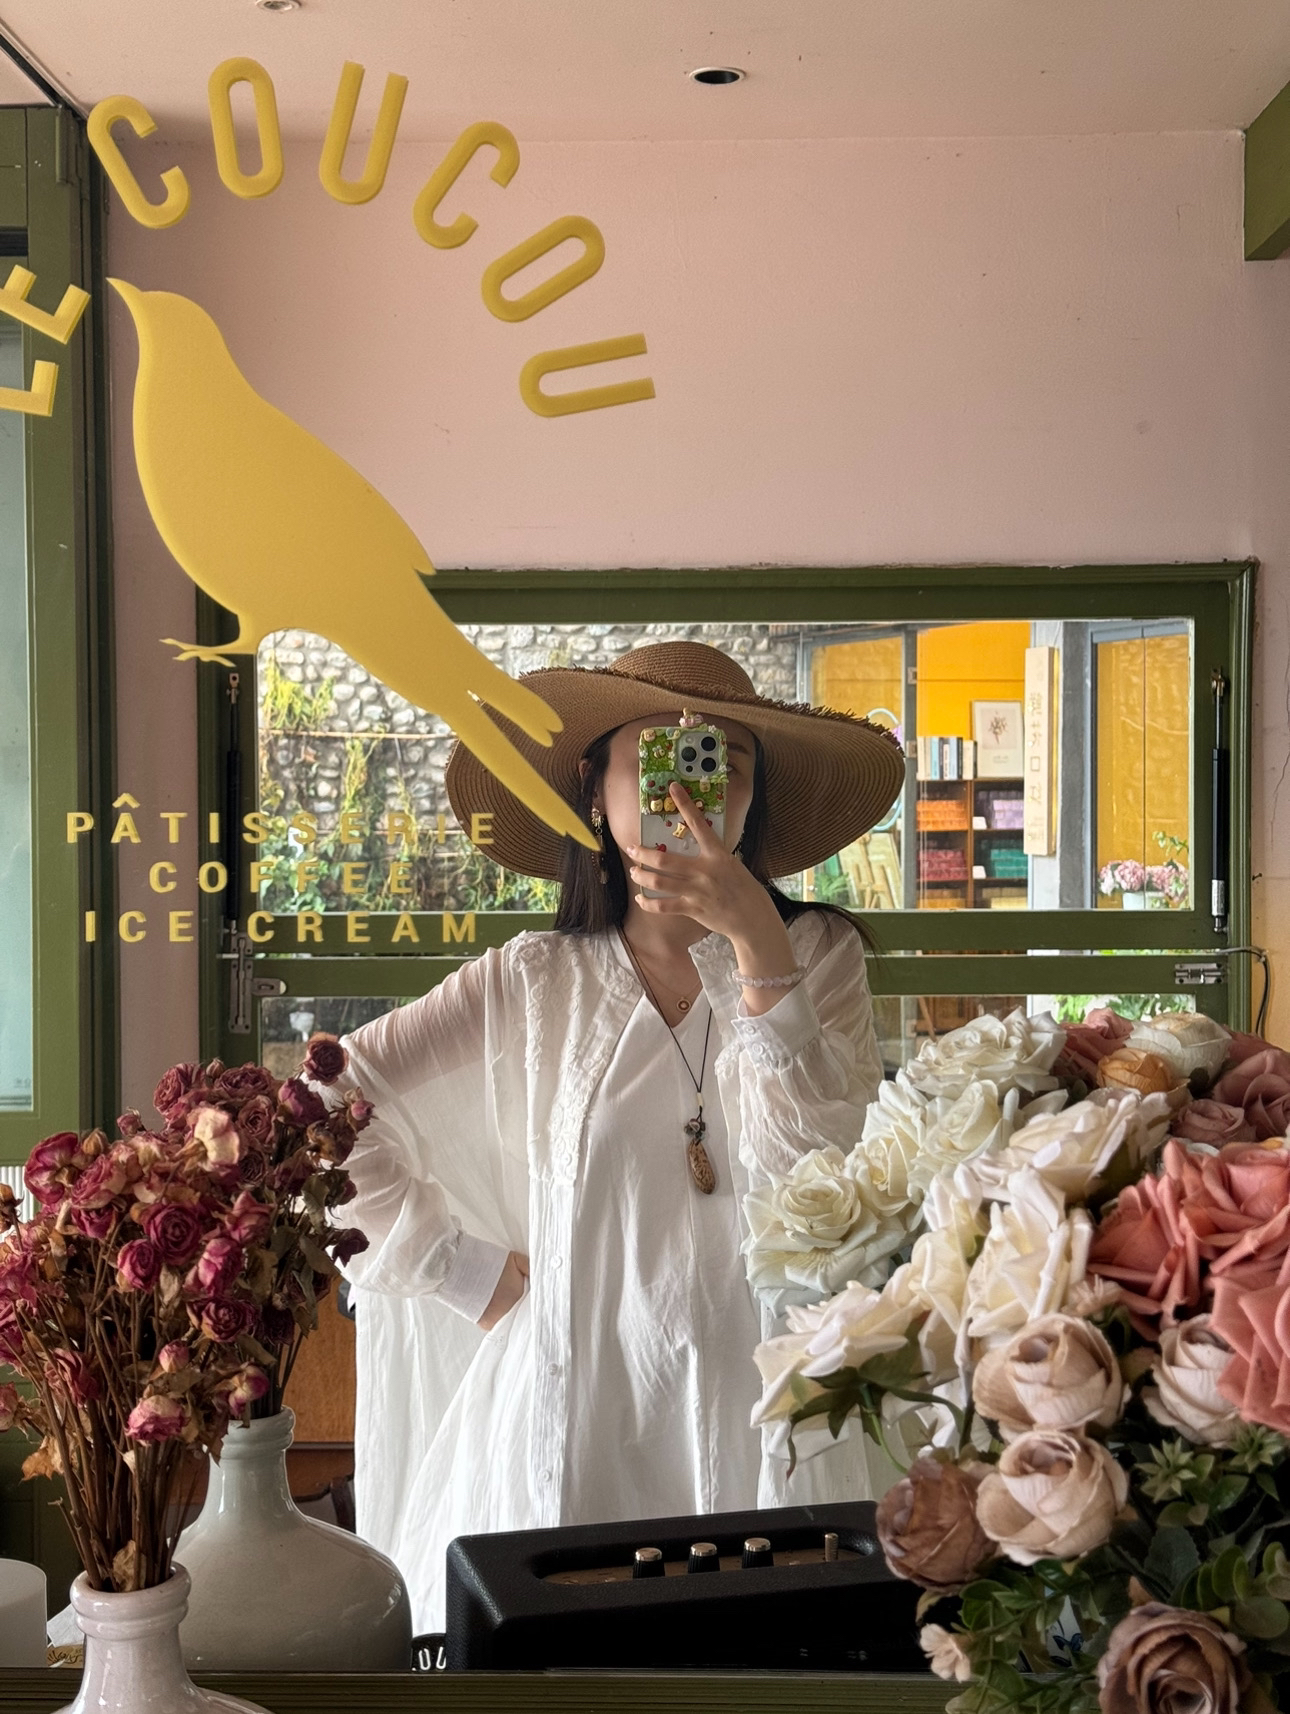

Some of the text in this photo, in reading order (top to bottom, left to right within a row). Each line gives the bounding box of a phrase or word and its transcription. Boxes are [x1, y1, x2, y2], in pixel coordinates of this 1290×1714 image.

[87, 57, 656, 417] COUCOU
[66, 792, 495, 844] PÂTISSERIE
[149, 861, 413, 893] COFFEE
[85, 910, 477, 942] ICE CREAM
